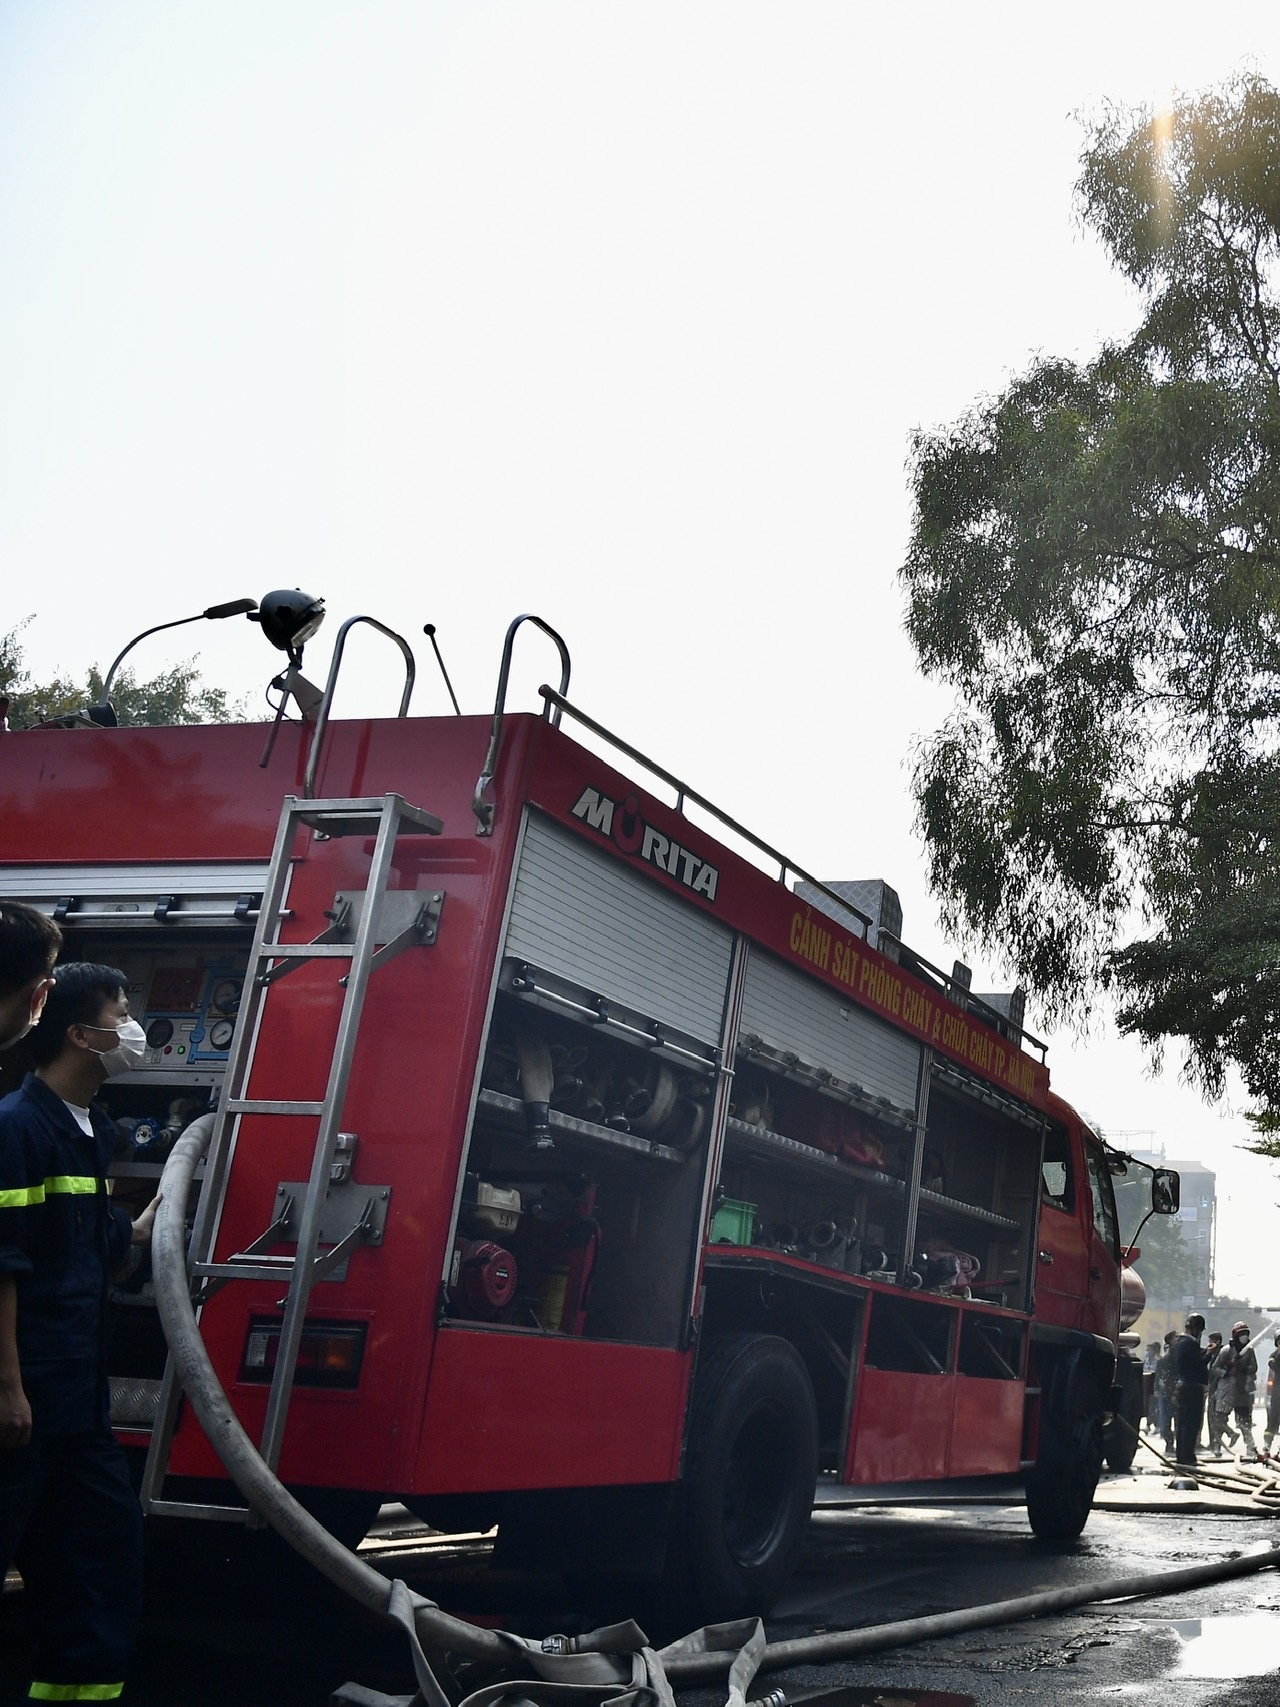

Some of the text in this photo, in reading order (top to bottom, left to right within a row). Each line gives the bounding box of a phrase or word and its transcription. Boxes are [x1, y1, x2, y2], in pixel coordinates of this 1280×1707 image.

[572, 787, 719, 901] MORITA
[790, 906, 832, 971] CẢNH
[832, 939, 859, 988] SÁT
[859, 961, 901, 1016] PHÒNG
[902, 987, 932, 1033] CHÁY
[931, 1007, 941, 1041] &
[942, 1013, 968, 1057] CHỮA
[970, 1031, 994, 1071] CHÁY
[1008, 1051, 1020, 1089] HÀ
[1021, 1062, 1035, 1100] NỘI
